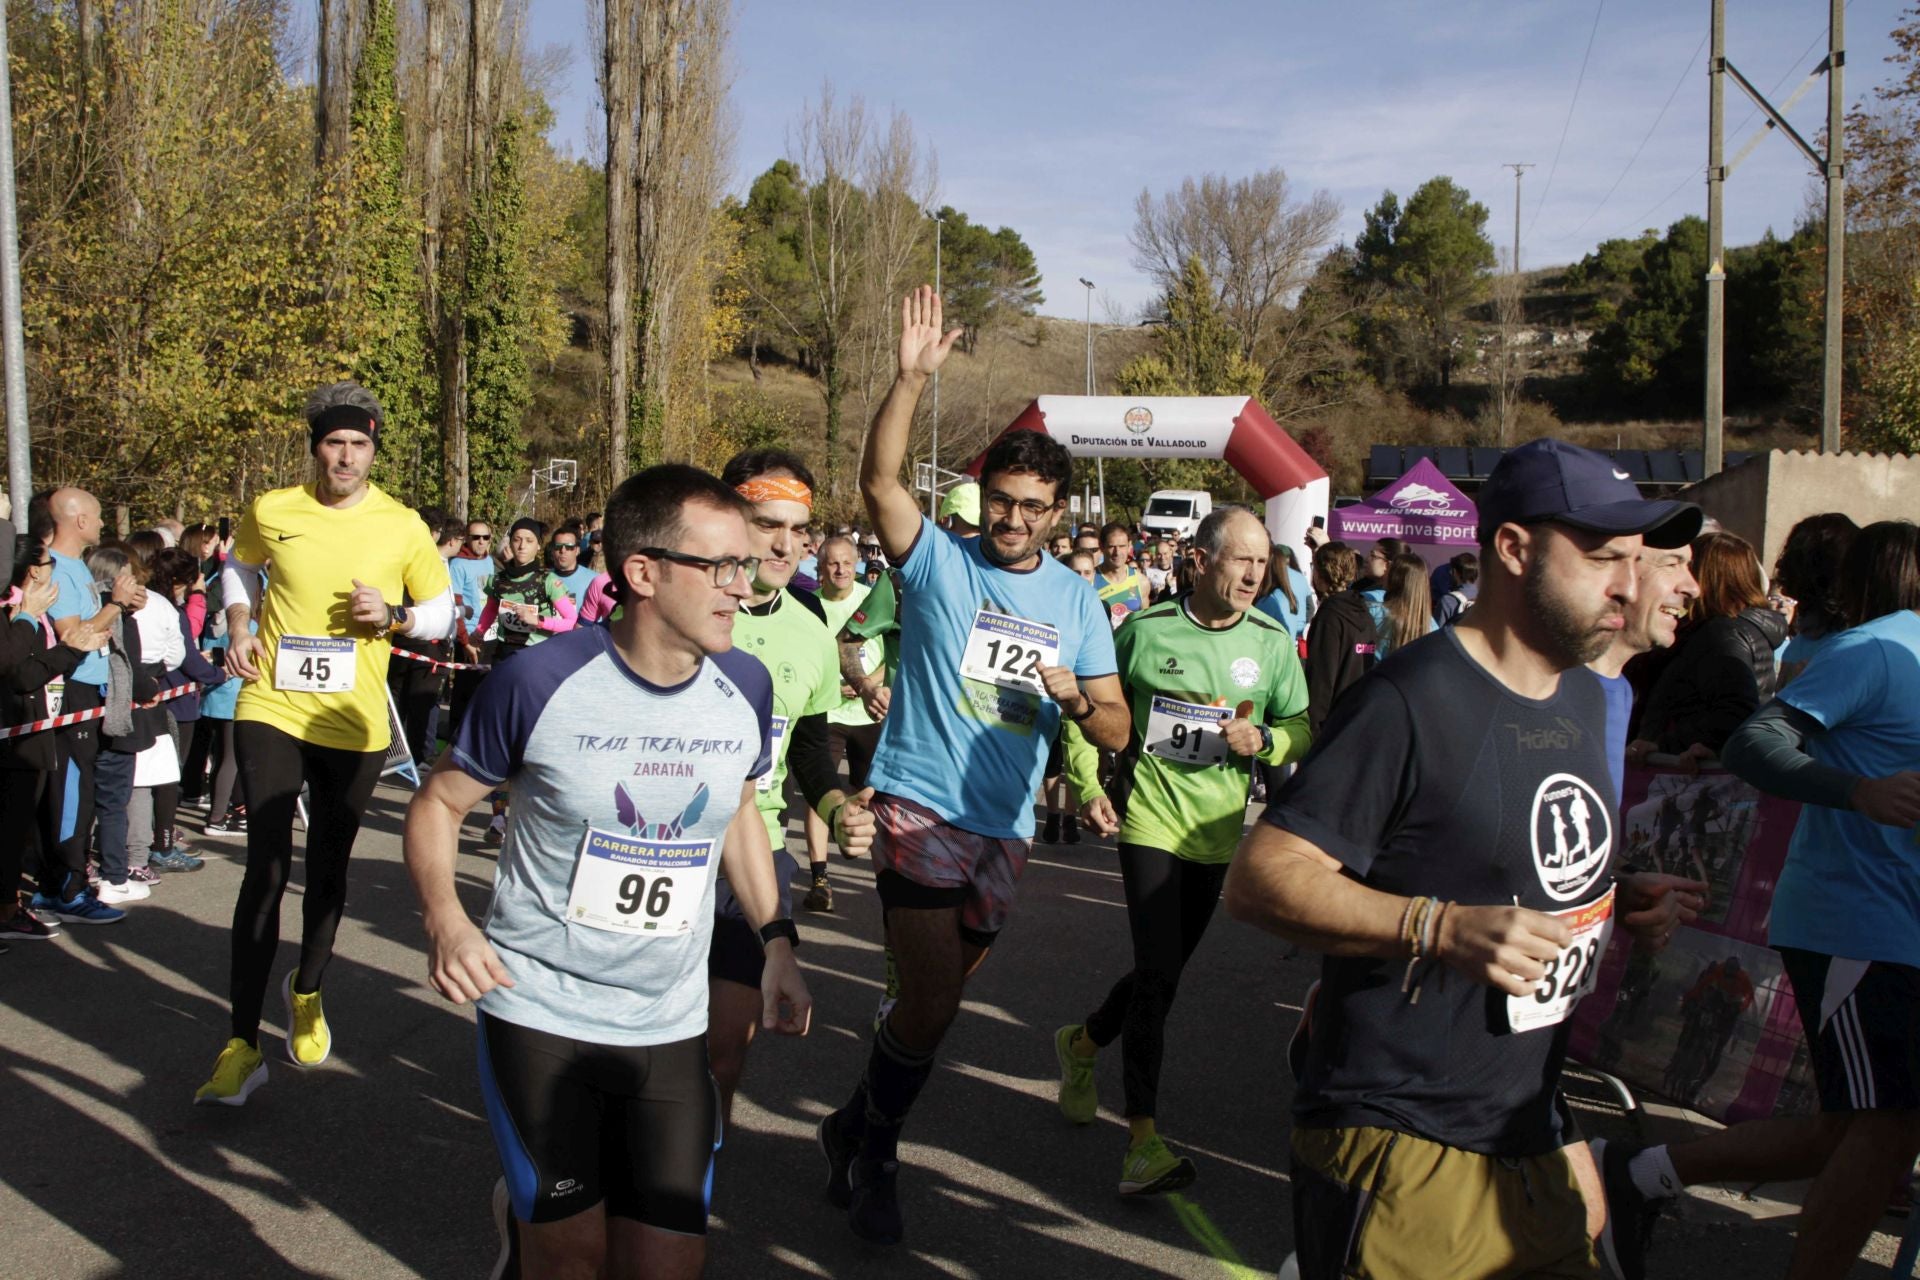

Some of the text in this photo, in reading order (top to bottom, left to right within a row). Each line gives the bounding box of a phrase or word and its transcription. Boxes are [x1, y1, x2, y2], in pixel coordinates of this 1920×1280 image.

[1131, 439, 1144, 447] DE
[1147, 437, 1207, 448] VALLADOLID
[980, 615, 1020, 632] CARRERA
[1022, 626, 1058, 642] POPULAR
[298, 656, 331, 682] 45
[987, 639, 1043, 680] 122
[1160, 701, 1192, 714] ARRERA
[574, 734, 629, 752] TRAIL
[1170, 723, 1204, 753] 91
[633, 760, 695, 777] ZARATÁN
[592, 837, 709, 859] CARRERA POPULAR
[615, 873, 674, 918] 96
[1535, 937, 1599, 1004] 328
